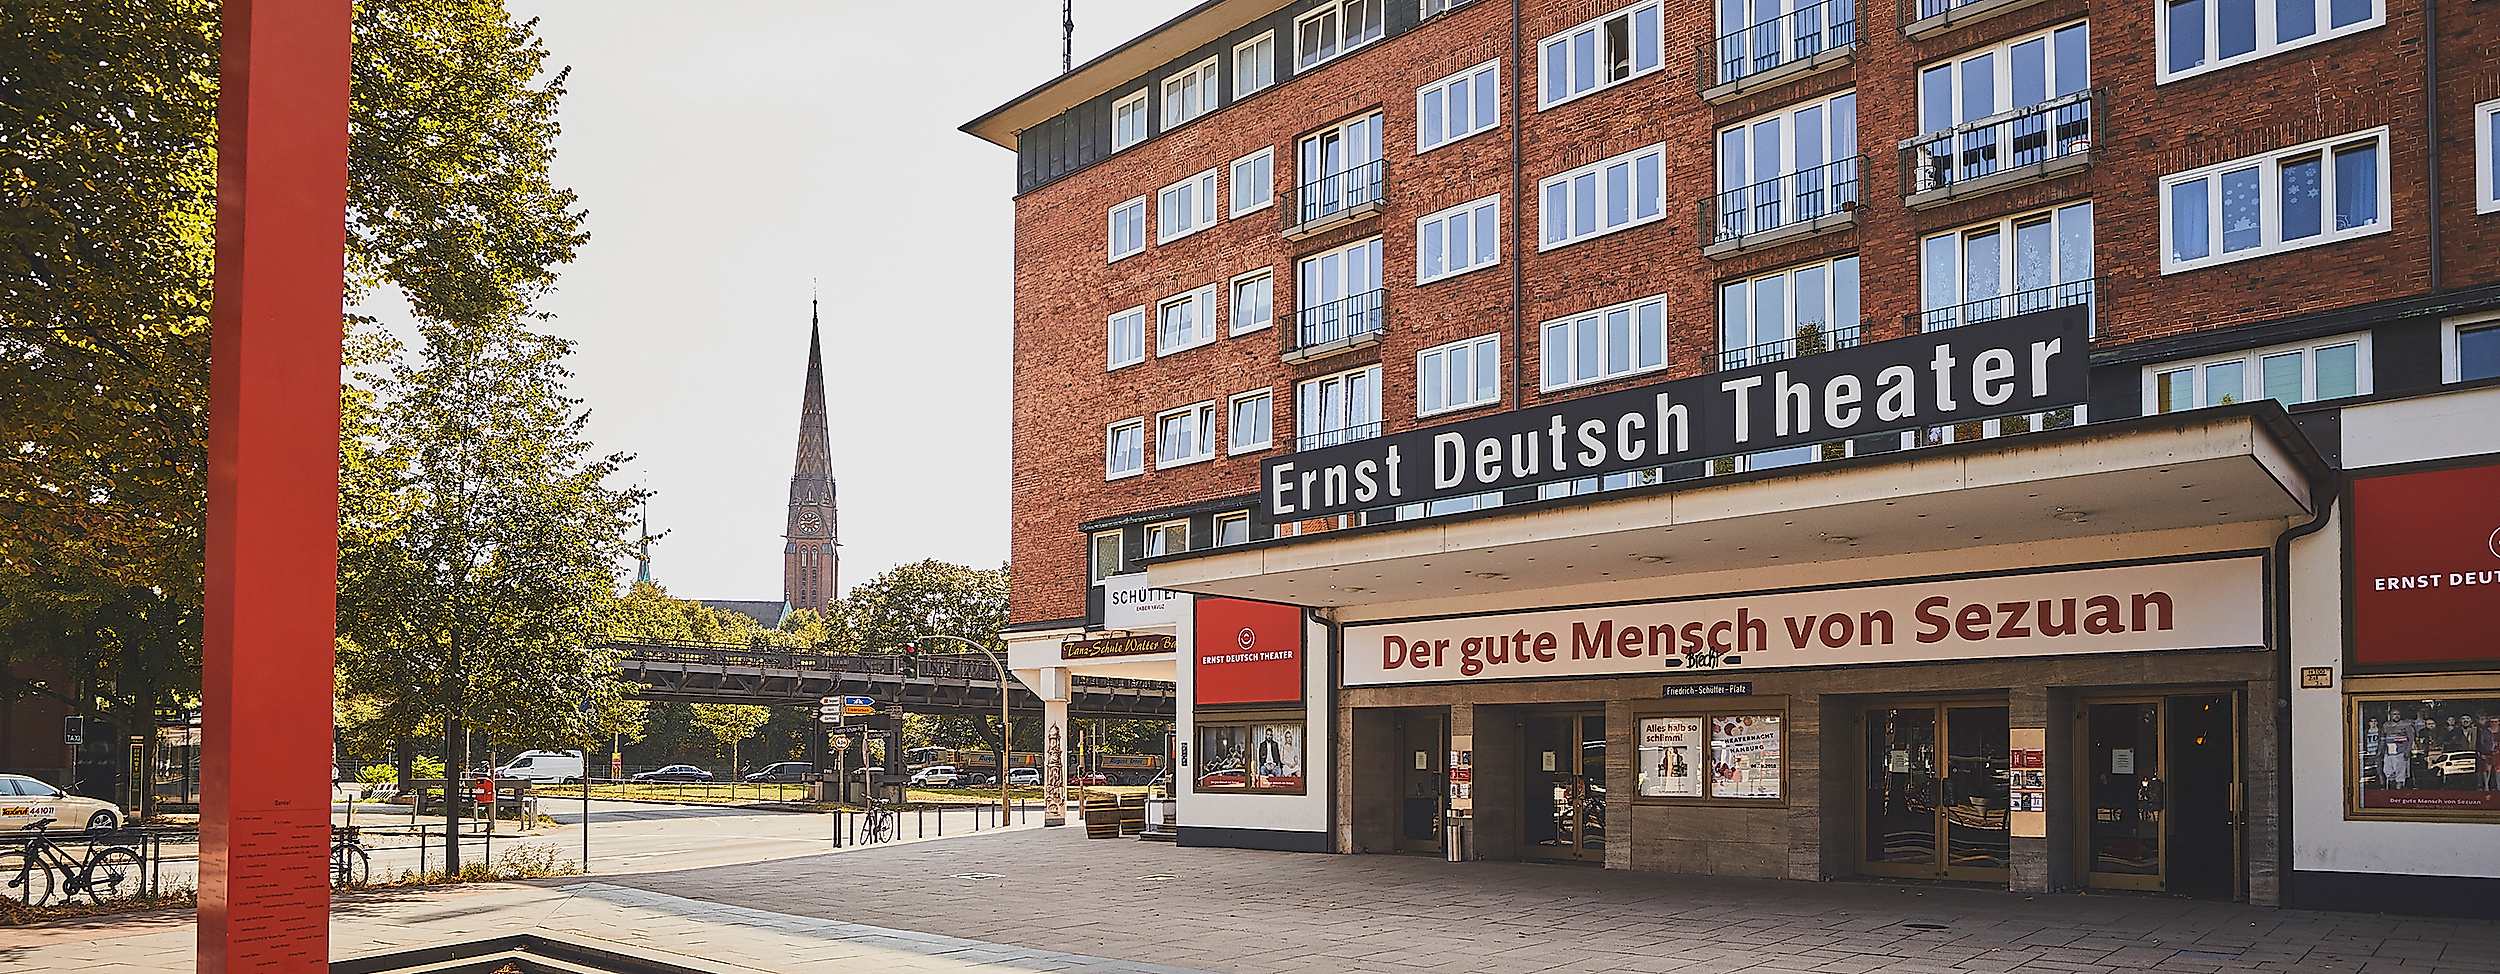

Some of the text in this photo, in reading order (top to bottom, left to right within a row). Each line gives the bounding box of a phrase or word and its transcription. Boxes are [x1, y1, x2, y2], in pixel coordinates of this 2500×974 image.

[1272, 338, 2063, 515] Ernst Deutsch Theater
[2374, 574, 2442, 591] ERNST
[1382, 590, 2175, 677] Der gute Mensch von Sezuan
[1063, 640, 1122, 657] Tanz-Schule
[1125, 638, 1159, 652] Walter
[1202, 651, 1294, 665] ERNST DEUTSCH THEATER
[1685, 644, 1725, 669] Brecht
[1646, 725, 1667, 733] Alles
[1667, 724, 1686, 732] halb
[1646, 733, 1683, 743] schlimm!
[1730, 744, 1765, 753] HAMBURG
